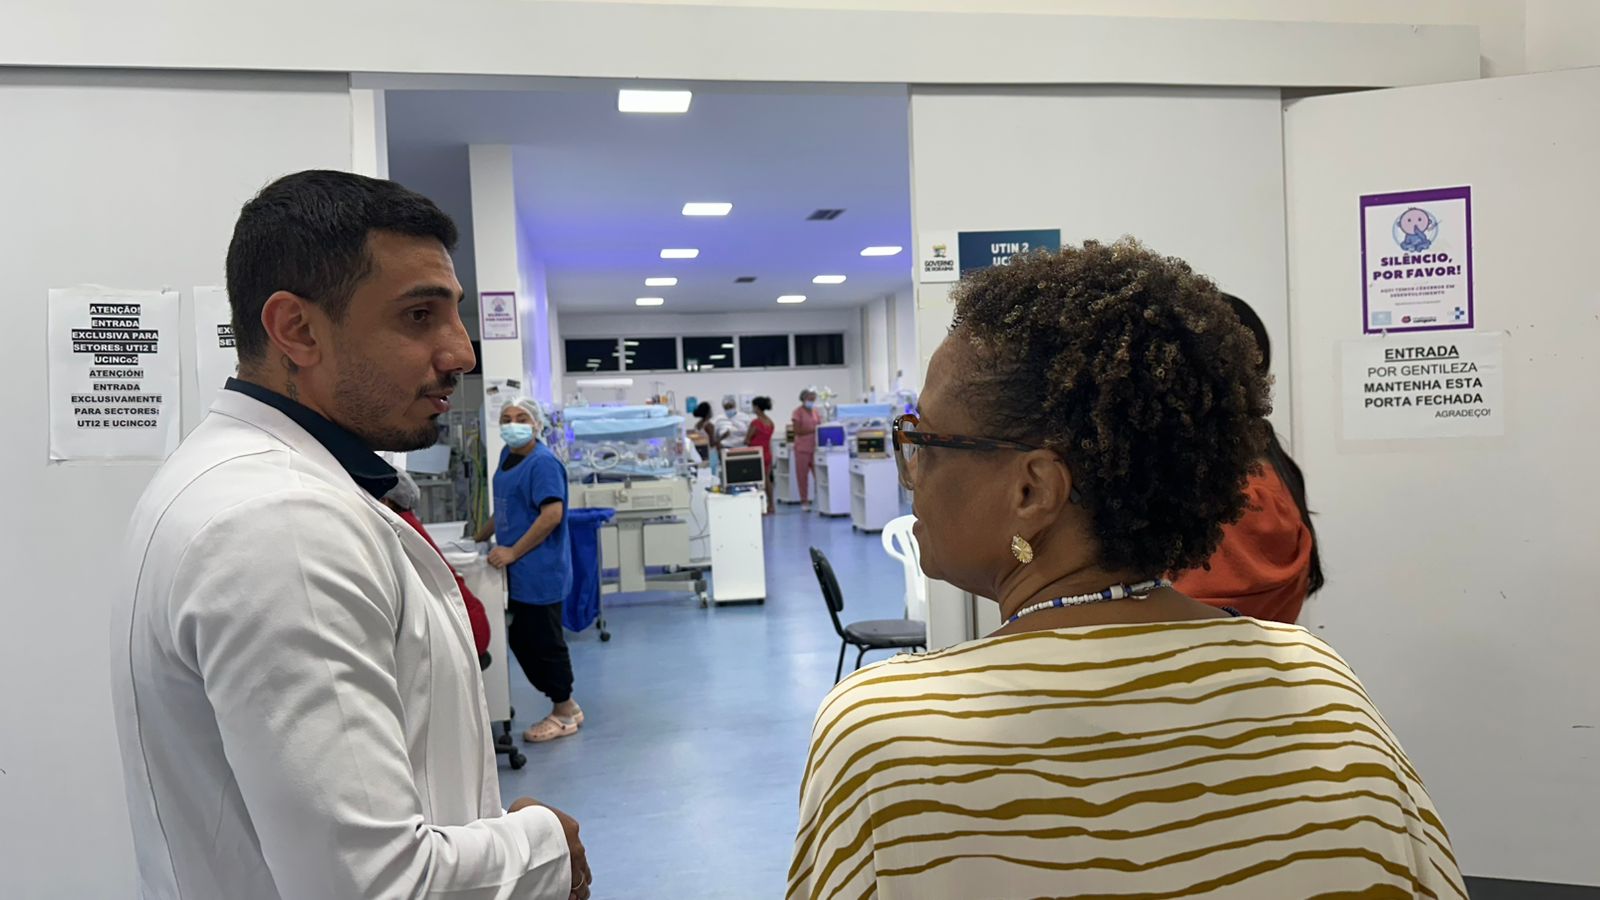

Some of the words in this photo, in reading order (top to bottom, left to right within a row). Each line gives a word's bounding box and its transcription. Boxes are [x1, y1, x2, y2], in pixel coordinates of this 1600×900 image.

[991, 243, 1019, 254] UTIN
[1021, 242, 1030, 253] 2
[1380, 253, 1453, 267] SILÊNCIO,
[1373, 270, 1403, 280] POR
[1406, 265, 1461, 278] FAVOR!
[90, 305, 141, 315] ATENÇÃO!
[92, 319, 139, 328] ENTRADA
[72, 331, 130, 340] EXCLUSIVA
[132, 332, 158, 340] PARA
[73, 343, 124, 352] SETORES:
[126, 344, 149, 352] UTI2
[151, 344, 158, 352] E
[1384, 345, 1460, 361] ENTRADA
[95, 356, 138, 364] UCINCo2
[1367, 366, 1397, 377] POR
[1400, 362, 1478, 376] GENTILEZA
[93, 383, 140, 391] ENTRADA
[1364, 379, 1442, 393] MANTENHA
[1445, 377, 1483, 389] ESTA
[71, 395, 163, 403] EXCLUSIVAMENTE
[1364, 396, 1412, 408] PORTA
[1415, 393, 1483, 406] FECHADA
[74, 407, 102, 415] PARA
[104, 407, 160, 415] SECTORES:
[1434, 408, 1491, 418] AGRADEÇO!
